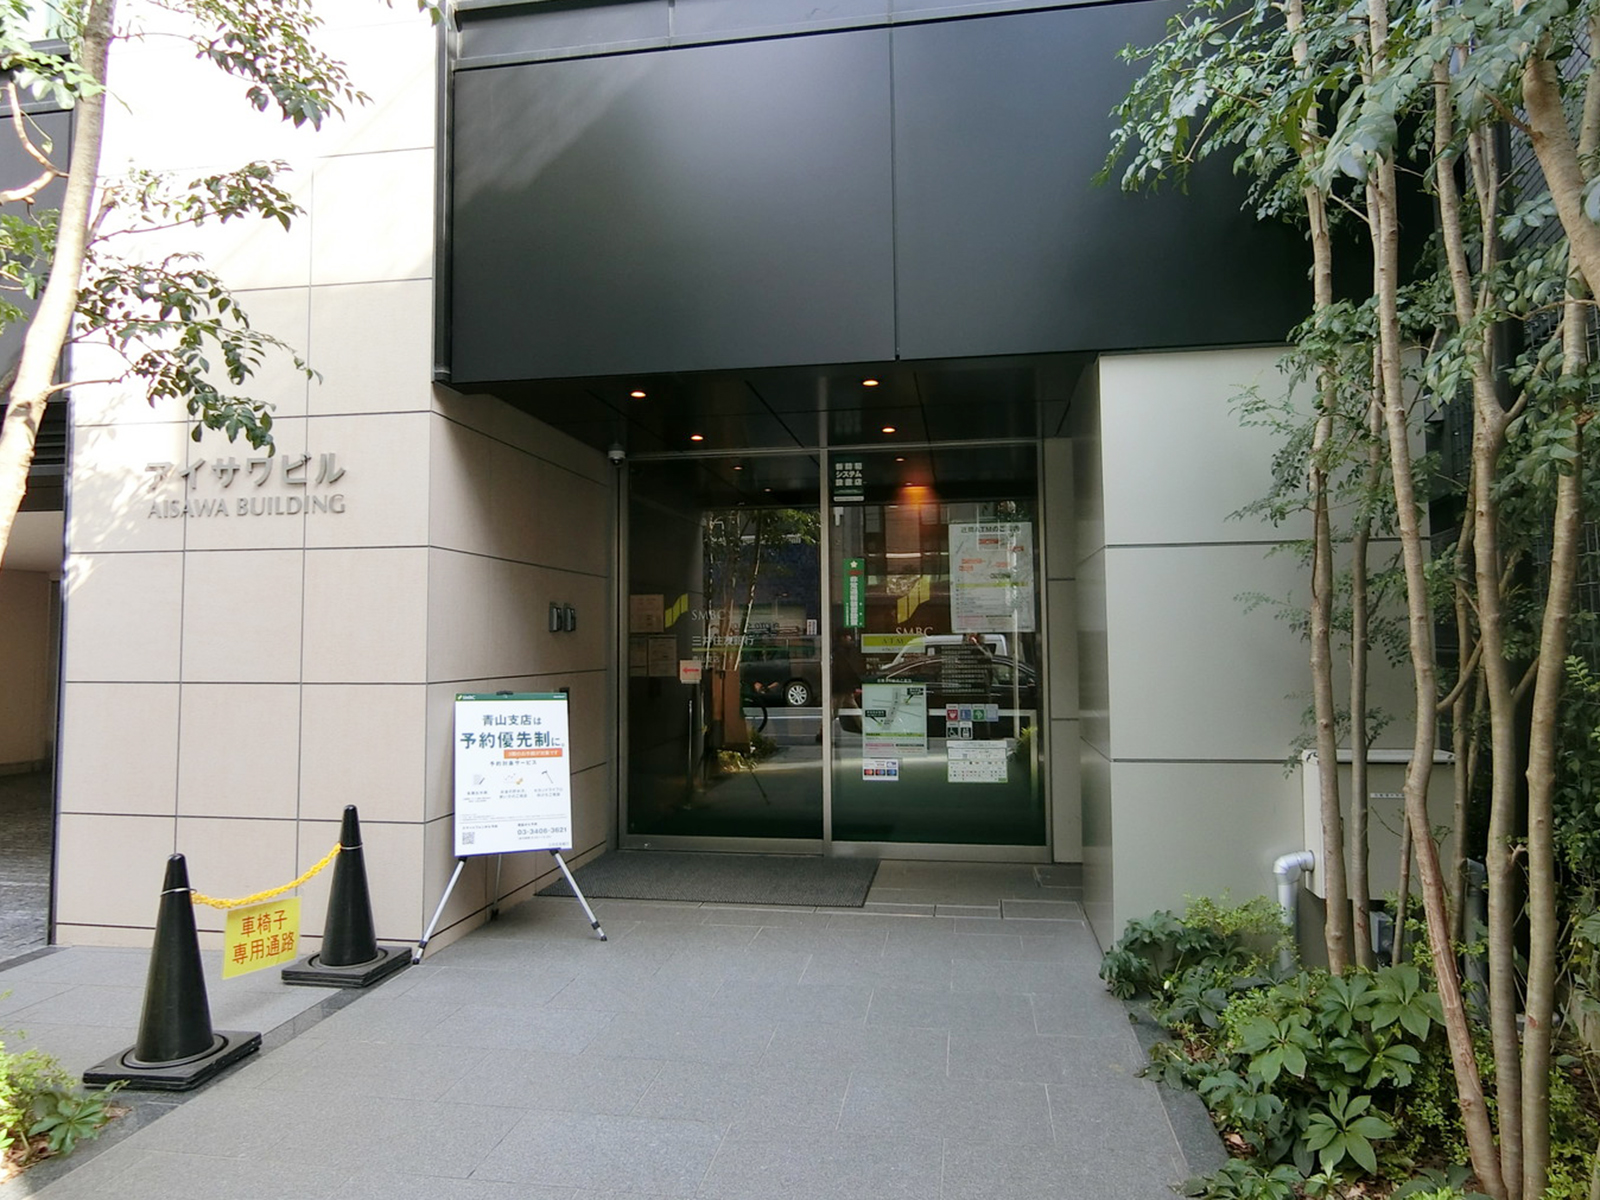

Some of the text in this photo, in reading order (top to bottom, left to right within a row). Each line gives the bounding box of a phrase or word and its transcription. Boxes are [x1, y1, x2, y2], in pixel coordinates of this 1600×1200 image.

[145, 452, 346, 492] アイサワビル
[835, 470, 862, 478] システム
[148, 493, 346, 519] AISAWA BUILDING
[691, 609, 729, 620] SMBC
[895, 626, 934, 638] SMBC
[483, 714, 542, 726] 青山支店は
[460, 731, 566, 749] 予約優先制に。
[241, 910, 288, 937] 車椅子
[232, 931, 295, 965] 専用通路
